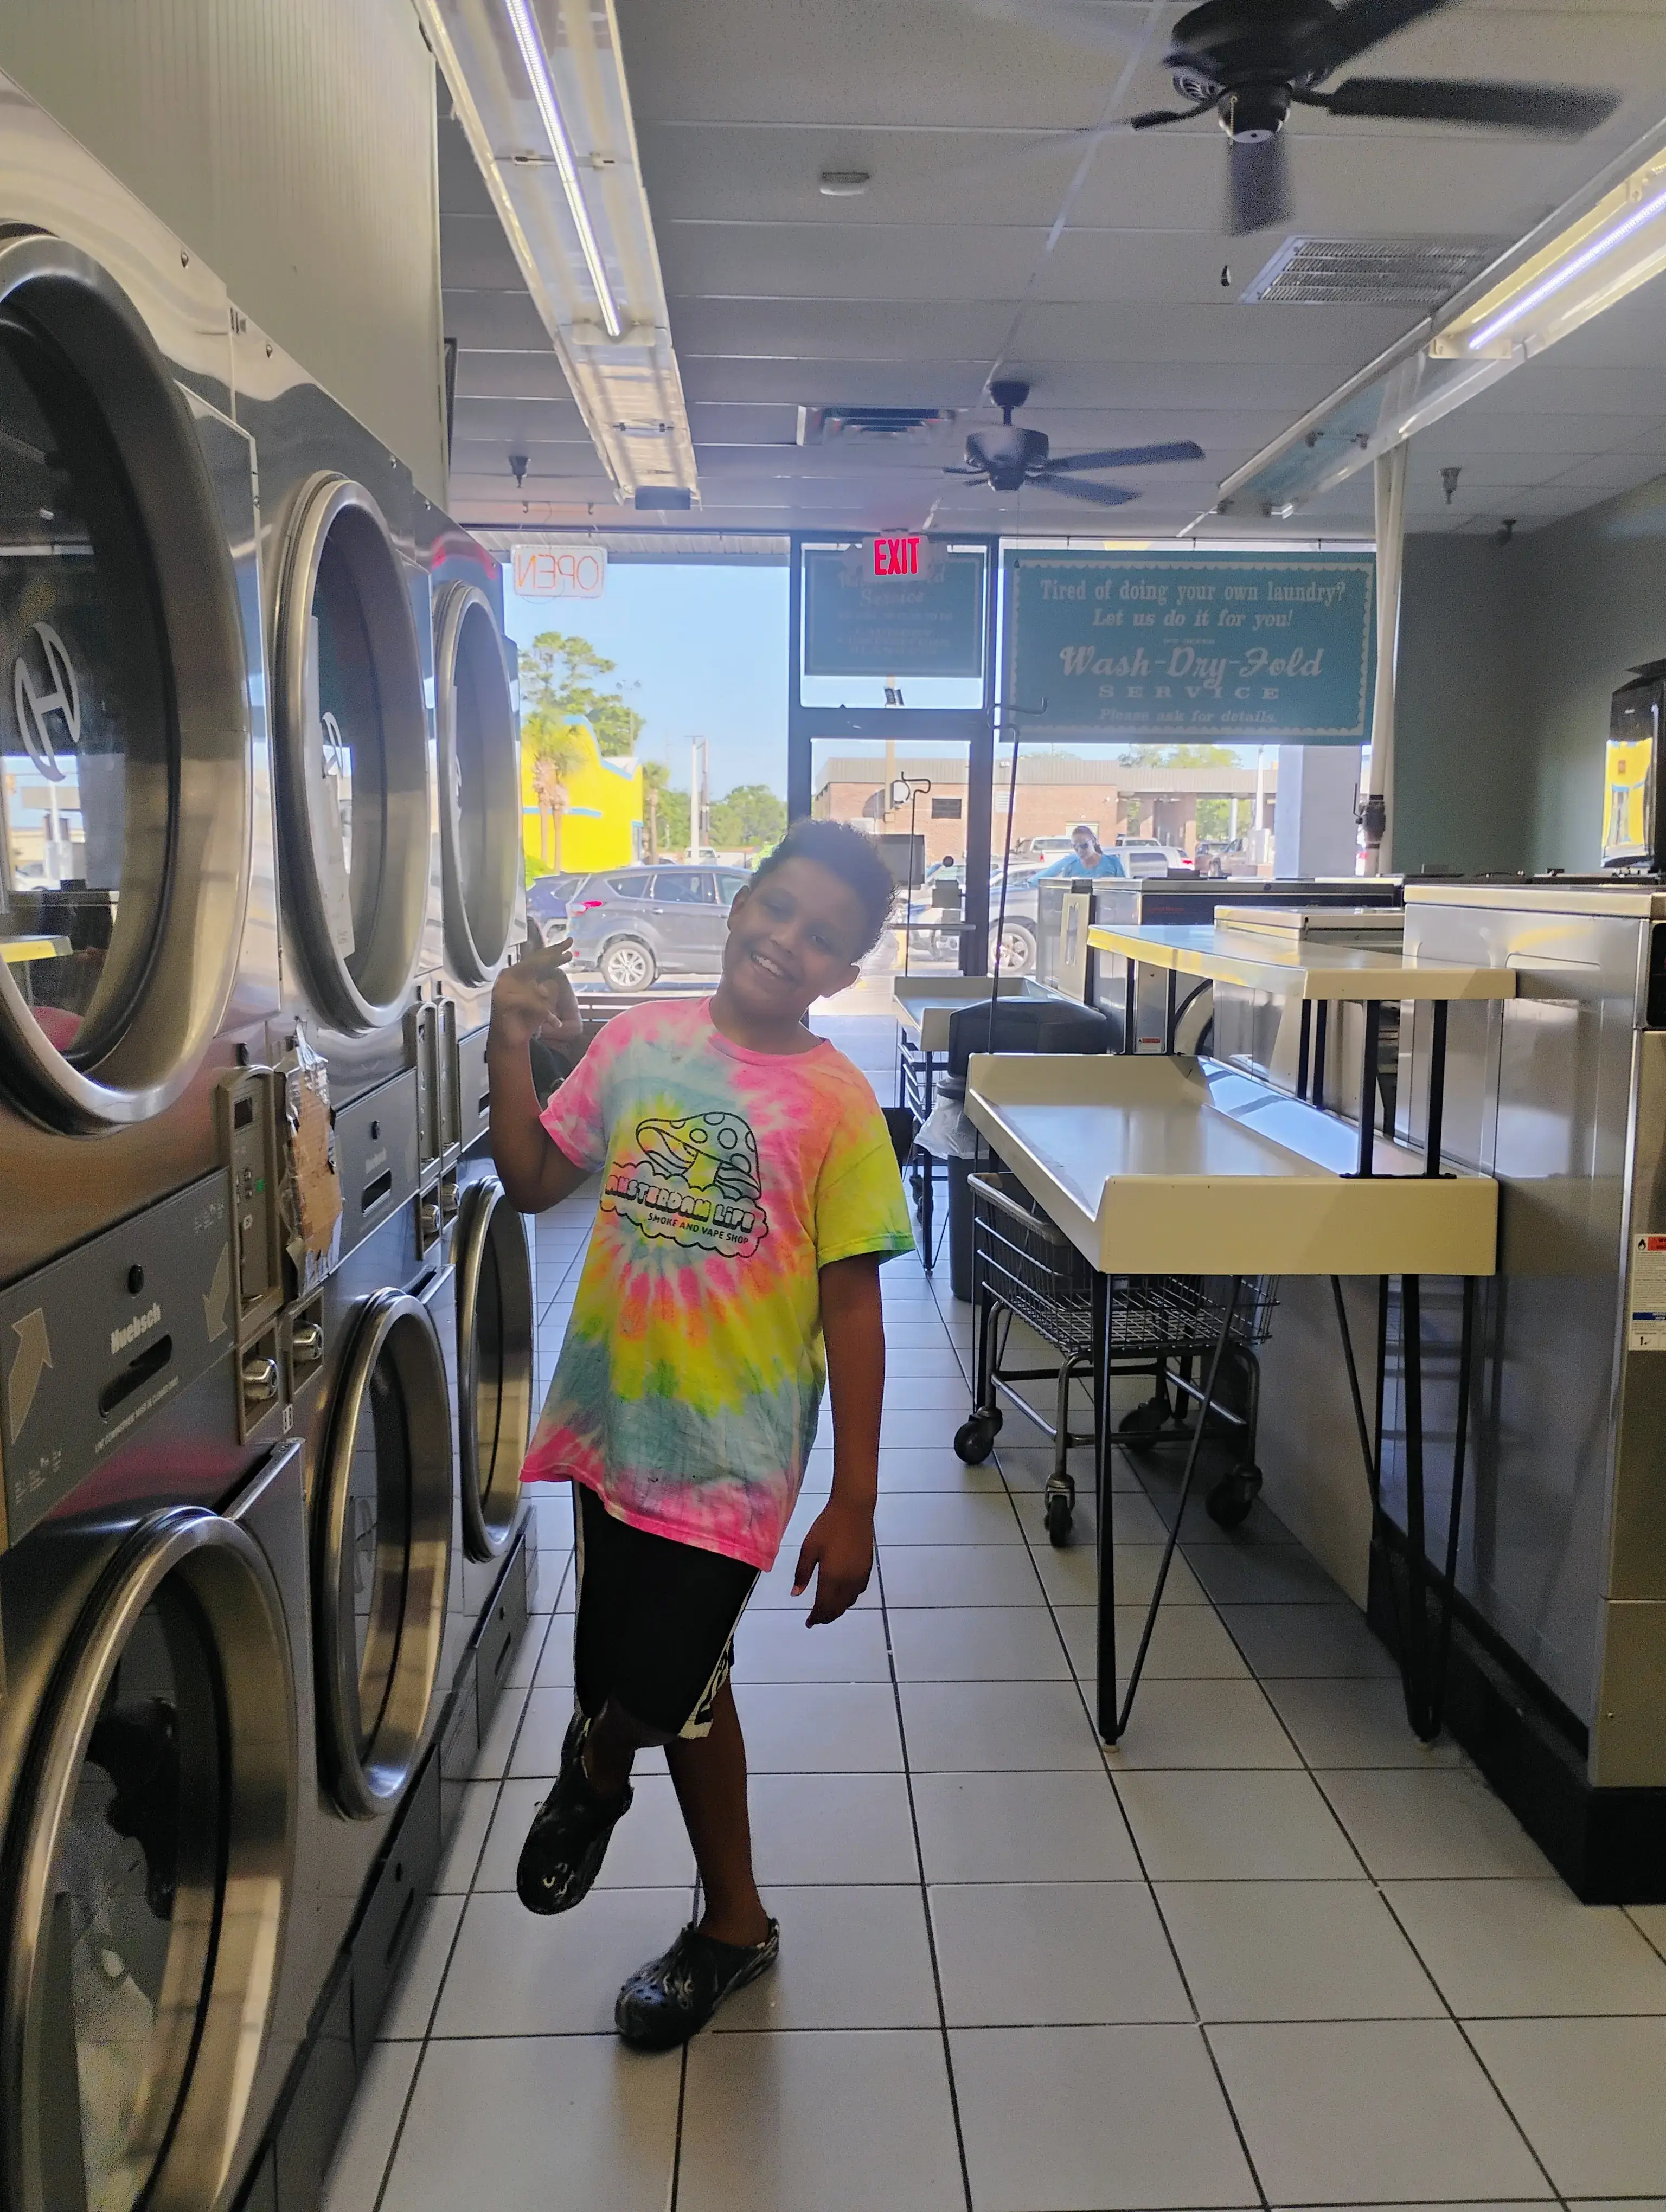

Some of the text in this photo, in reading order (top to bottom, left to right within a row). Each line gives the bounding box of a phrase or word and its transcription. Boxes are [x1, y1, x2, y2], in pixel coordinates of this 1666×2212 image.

[874, 538, 920, 575] EXIT
[1040, 579, 1345, 606] Tired of doing your own laundry?
[1092, 609, 1293, 631] Let us do it for you!
[1099, 686, 1279, 699] SERVICE
[1099, 708, 1149, 722] Please
[1156, 709, 1183, 722] ask
[1192, 709, 1214, 722] for
[648, 1213, 748, 1244] SMOKE AND VAPE SHOP
